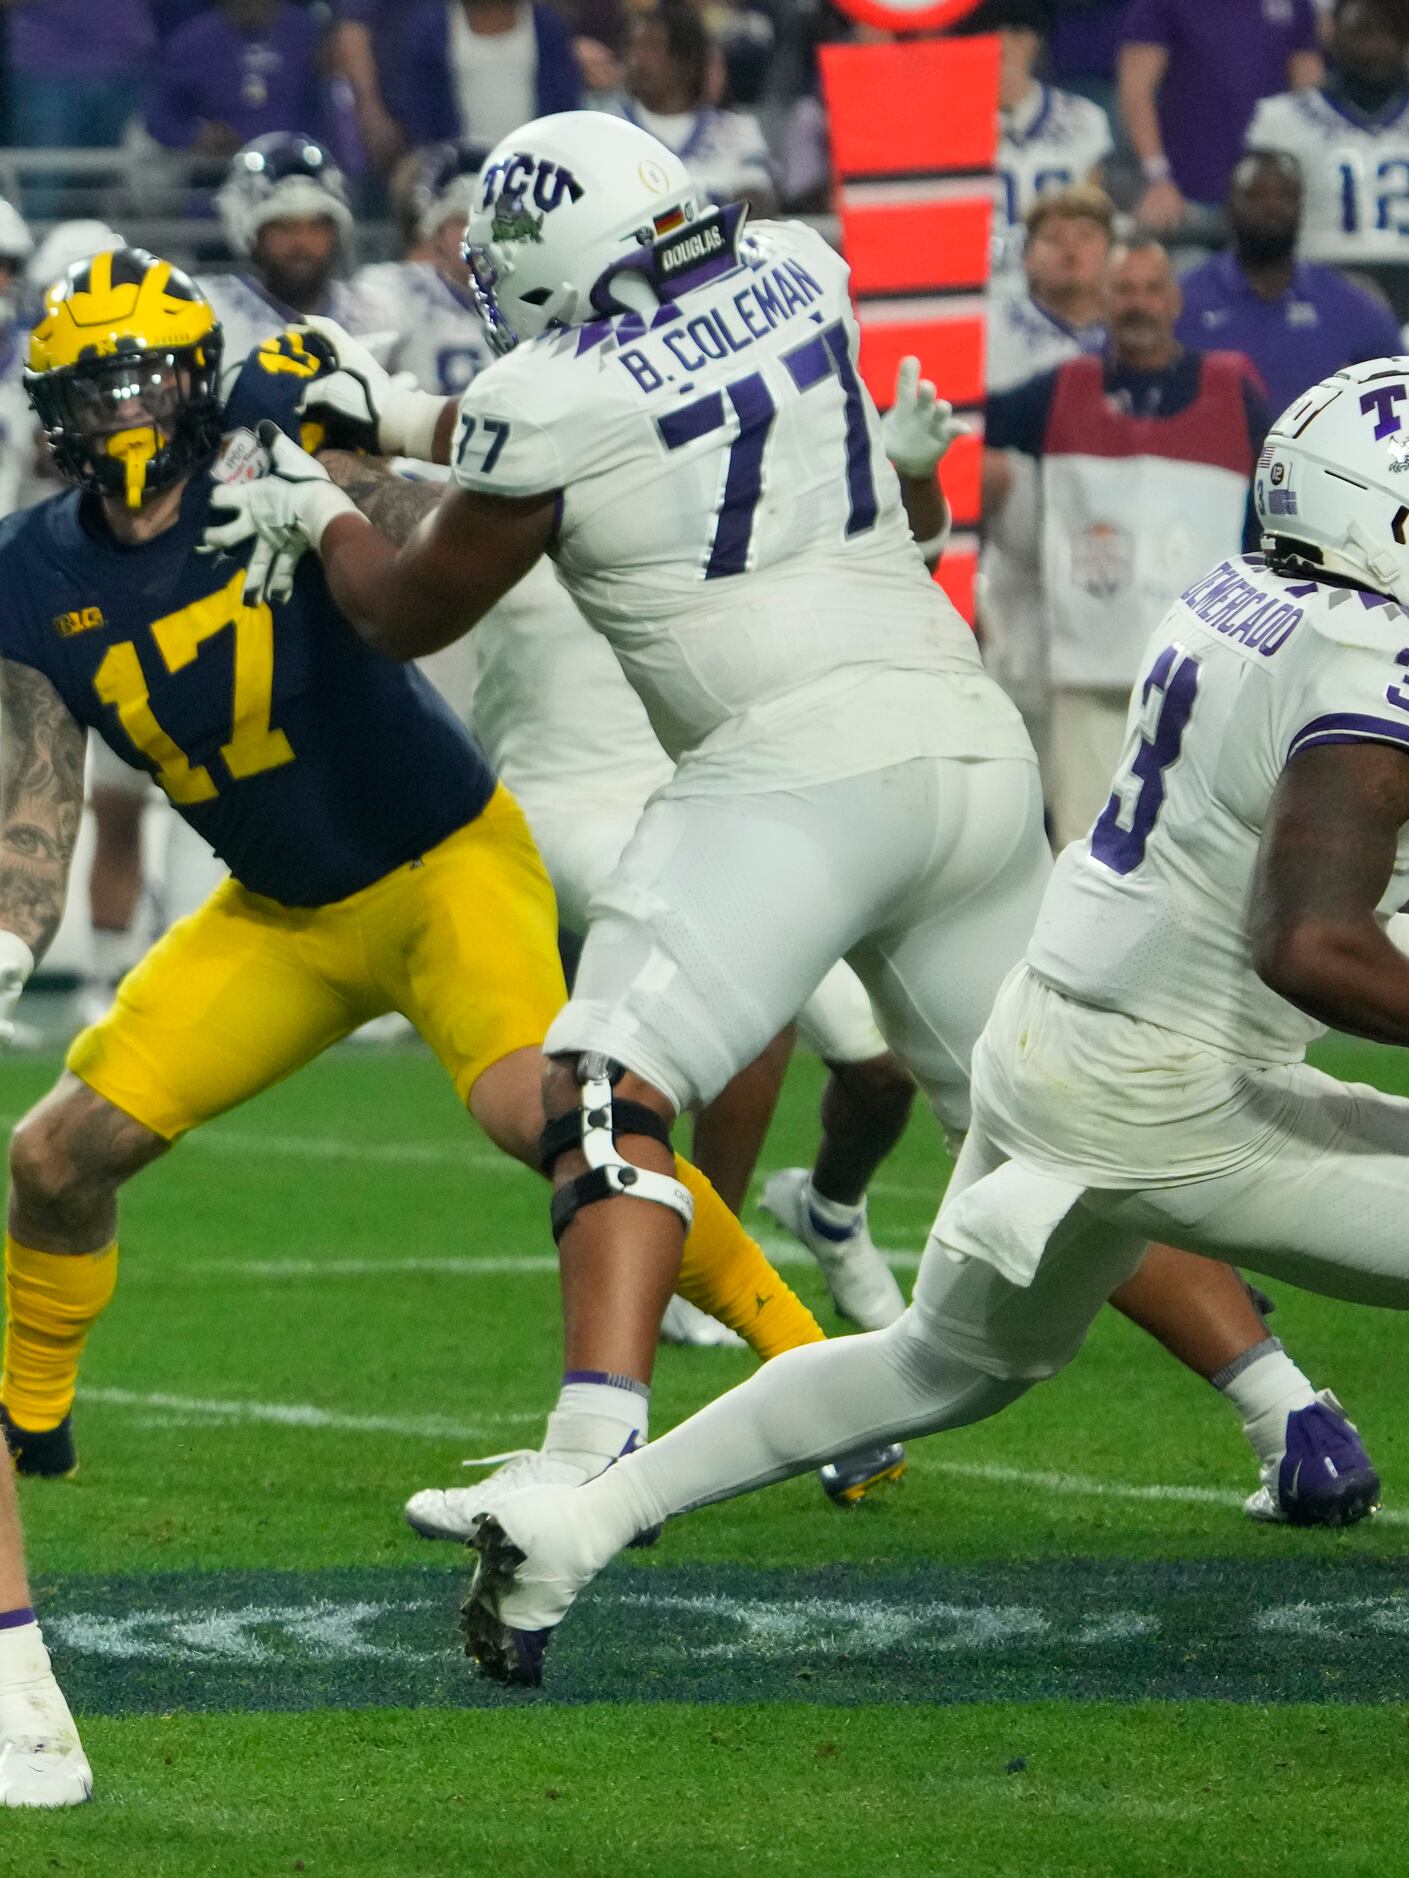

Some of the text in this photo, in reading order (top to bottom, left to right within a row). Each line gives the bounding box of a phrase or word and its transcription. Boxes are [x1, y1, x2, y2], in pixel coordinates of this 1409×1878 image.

[482, 152, 585, 213] TCU
[618, 257, 824, 395] B. COLEMAN
[456, 412, 511, 475] 77
[656, 317, 881, 582] 77
[93, 568, 297, 806] 17
[1090, 643, 1201, 876] 3
